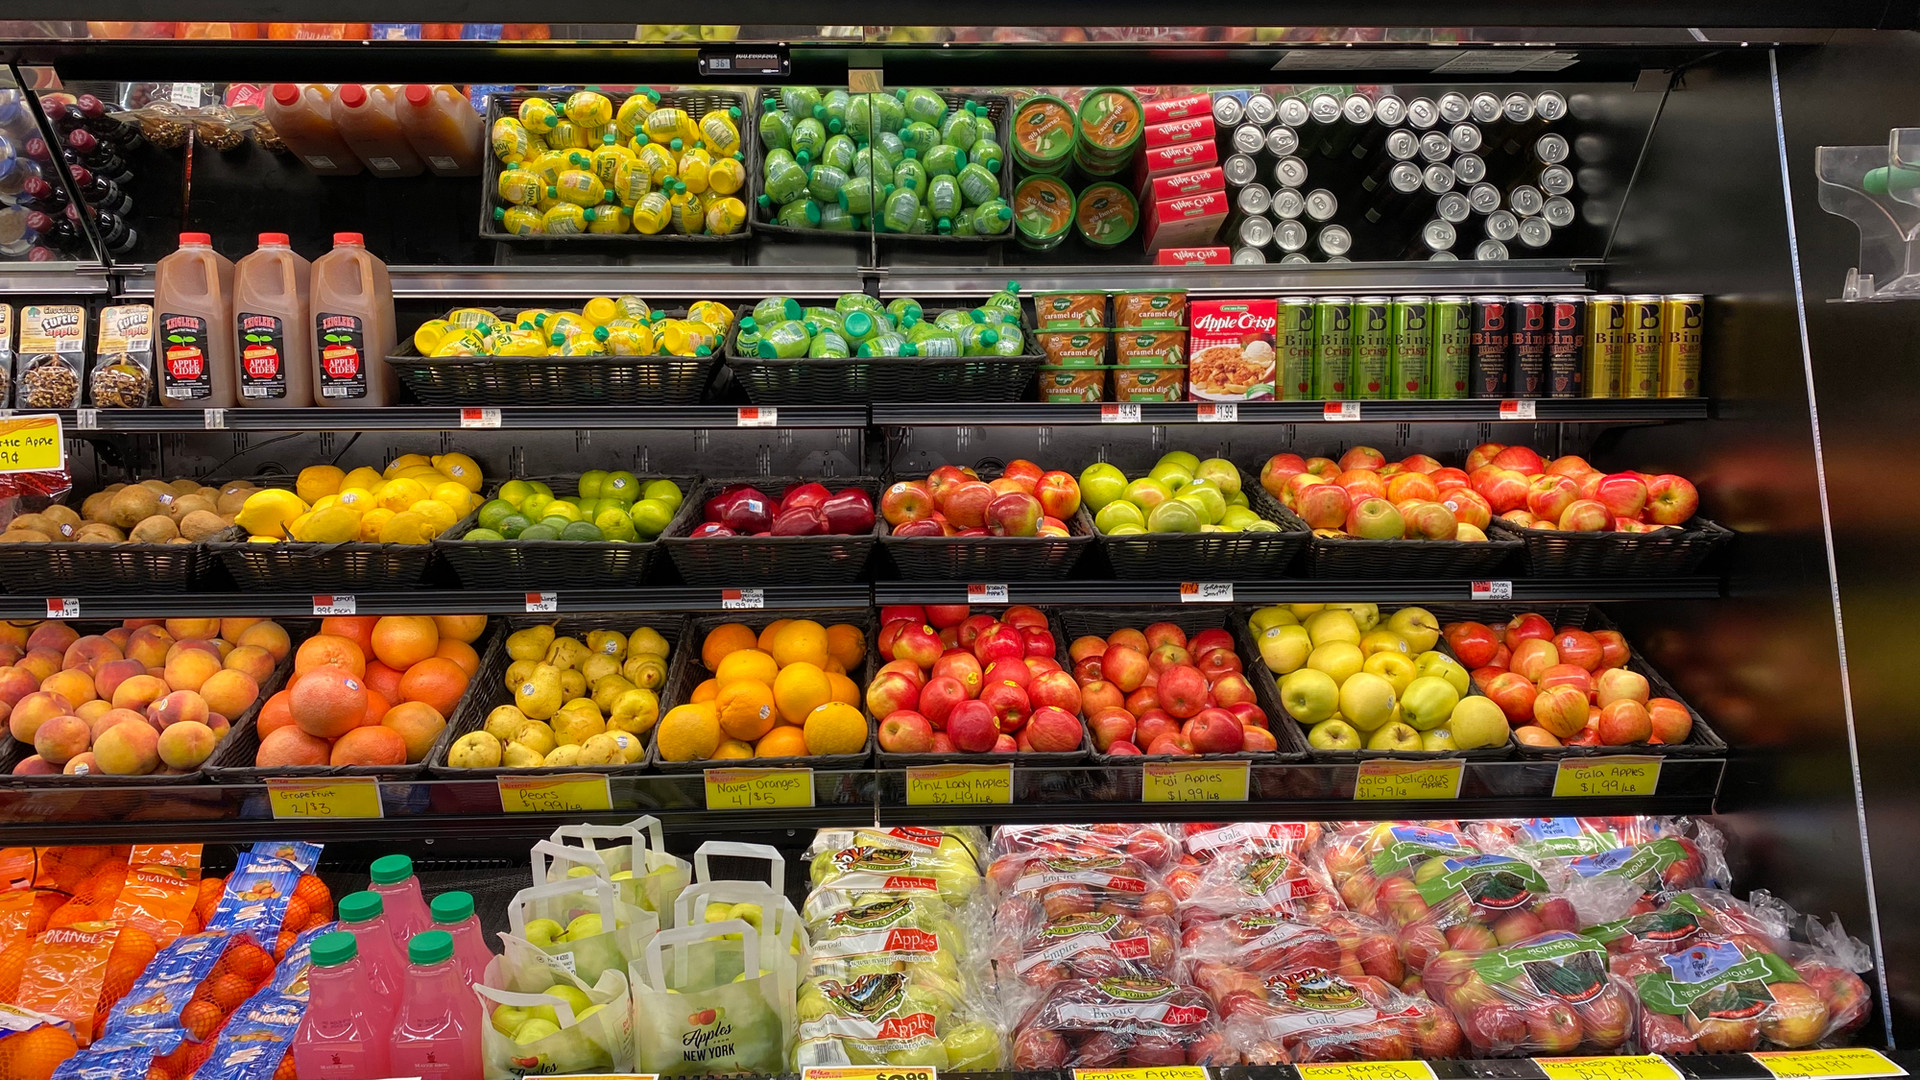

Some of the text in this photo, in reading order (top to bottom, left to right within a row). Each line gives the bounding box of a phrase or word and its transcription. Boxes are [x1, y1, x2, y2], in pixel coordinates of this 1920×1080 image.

[1044, 312, 1083, 320] caramel dip
[1138, 310, 1178, 319] caramel dip
[42, 314, 78, 330] turtle
[117, 314, 148, 330] turtle
[1194, 311, 1275, 332] Apple Crisp
[45, 326, 79, 338] apple
[120, 326, 148, 337] apple
[1356, 334, 1391, 347] Bing
[1395, 333, 1431, 347] Bing
[1546, 332, 1584, 347] Bing
[1088, 349, 1098, 358] dip
[1155, 349, 1167, 358] dip
[1359, 345, 1388, 357] Crisp
[1398, 345, 1427, 357] Crisp
[173, 359, 199, 368] APPLE
[249, 359, 275, 368] APPLE
[329, 359, 355, 368] APPLE
[173, 366, 200, 375] CIDER
[249, 366, 276, 375] CIDER
[329, 366, 356, 375] CIDER
[1073, 387, 1085, 395] dip
[1156, 386, 1168, 395] dip
[1120, 404, 1137, 417] $4.49
[1217, 404, 1234, 419] $1.99
[25, 437, 53, 447] Apple
[1575, 767, 1645, 779] Gala Apples
[717, 778, 800, 793] Navel Oranges
[912, 778, 1009, 792] Pink Lady Apples
[1155, 773, 1222, 786] Fuji Apples
[1359, 774, 1449, 785] Gold Delicious
[1421, 781, 1449, 789] Apples
[520, 789, 559, 800] Pears
[1218, 829, 1241, 842] Gala
[890, 877, 935, 889] Apples
[891, 931, 935, 949] Apples
[1260, 931, 1286, 947] Gala
[1307, 1014, 1337, 1025] Gala
[886, 1014, 934, 1038] Apples
[683, 1021, 733, 1049] Apples
[683, 1043, 735, 1061] NEW YORK
[1145, 1070, 1204, 1080] Apples
[1305, 1064, 1394, 1076] Gala Apples
